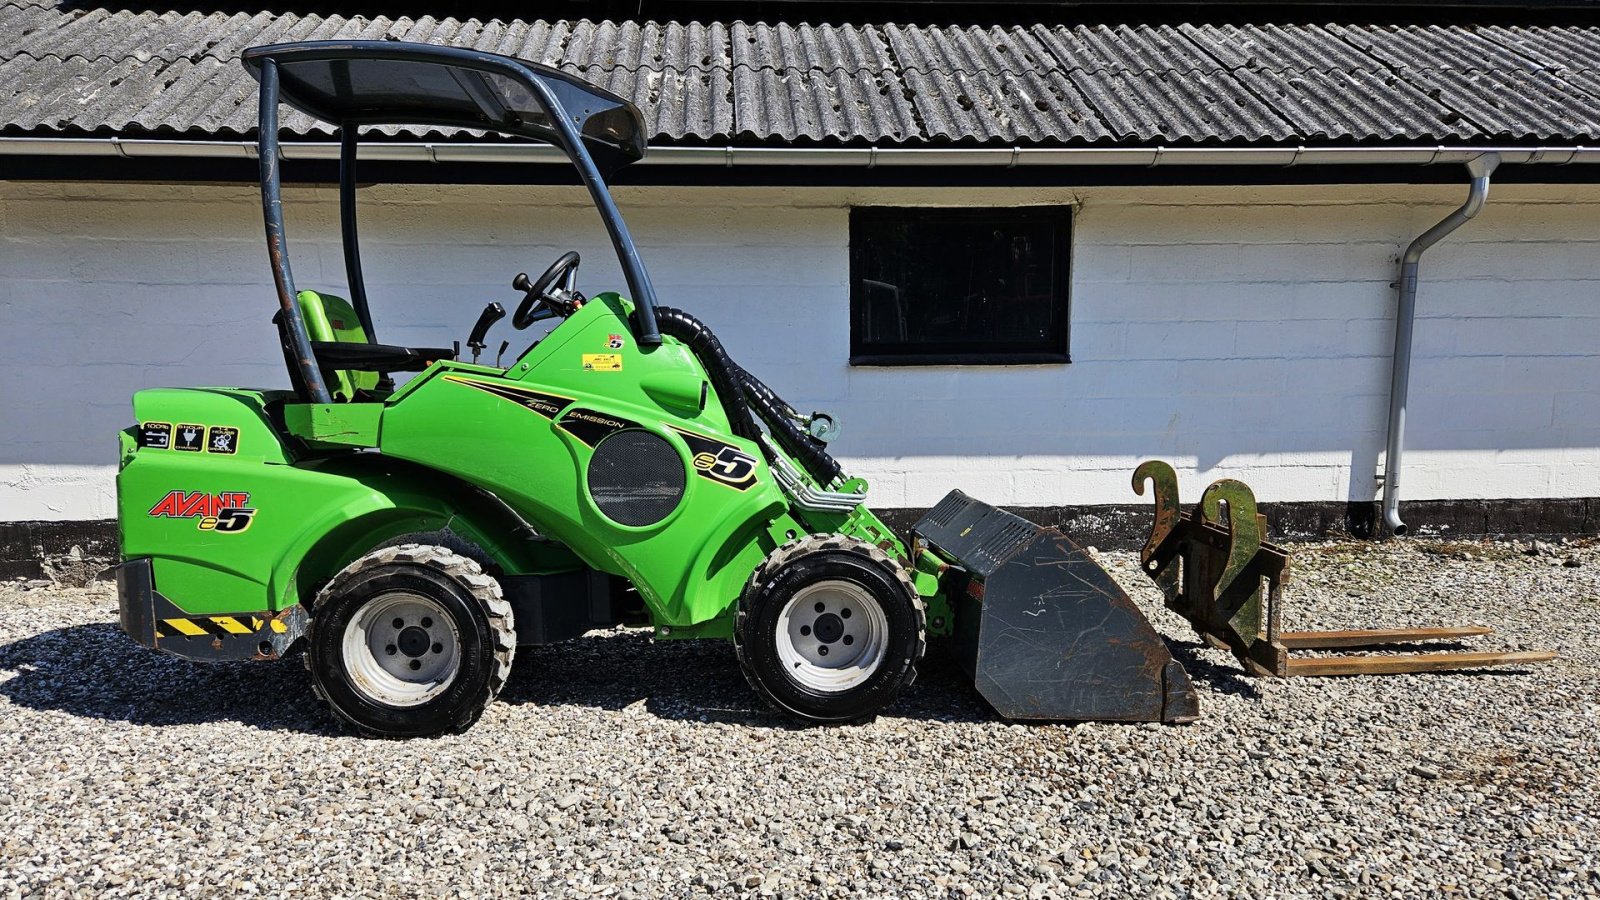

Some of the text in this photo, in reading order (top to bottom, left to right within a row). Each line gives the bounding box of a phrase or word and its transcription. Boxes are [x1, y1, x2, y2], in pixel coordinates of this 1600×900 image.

[527, 402, 559, 413] ZERO
[568, 411, 625, 428] EMISSION
[692, 446, 760, 483] e5
[148, 490, 250, 519] AVANT
[198, 508, 258, 534] e5
